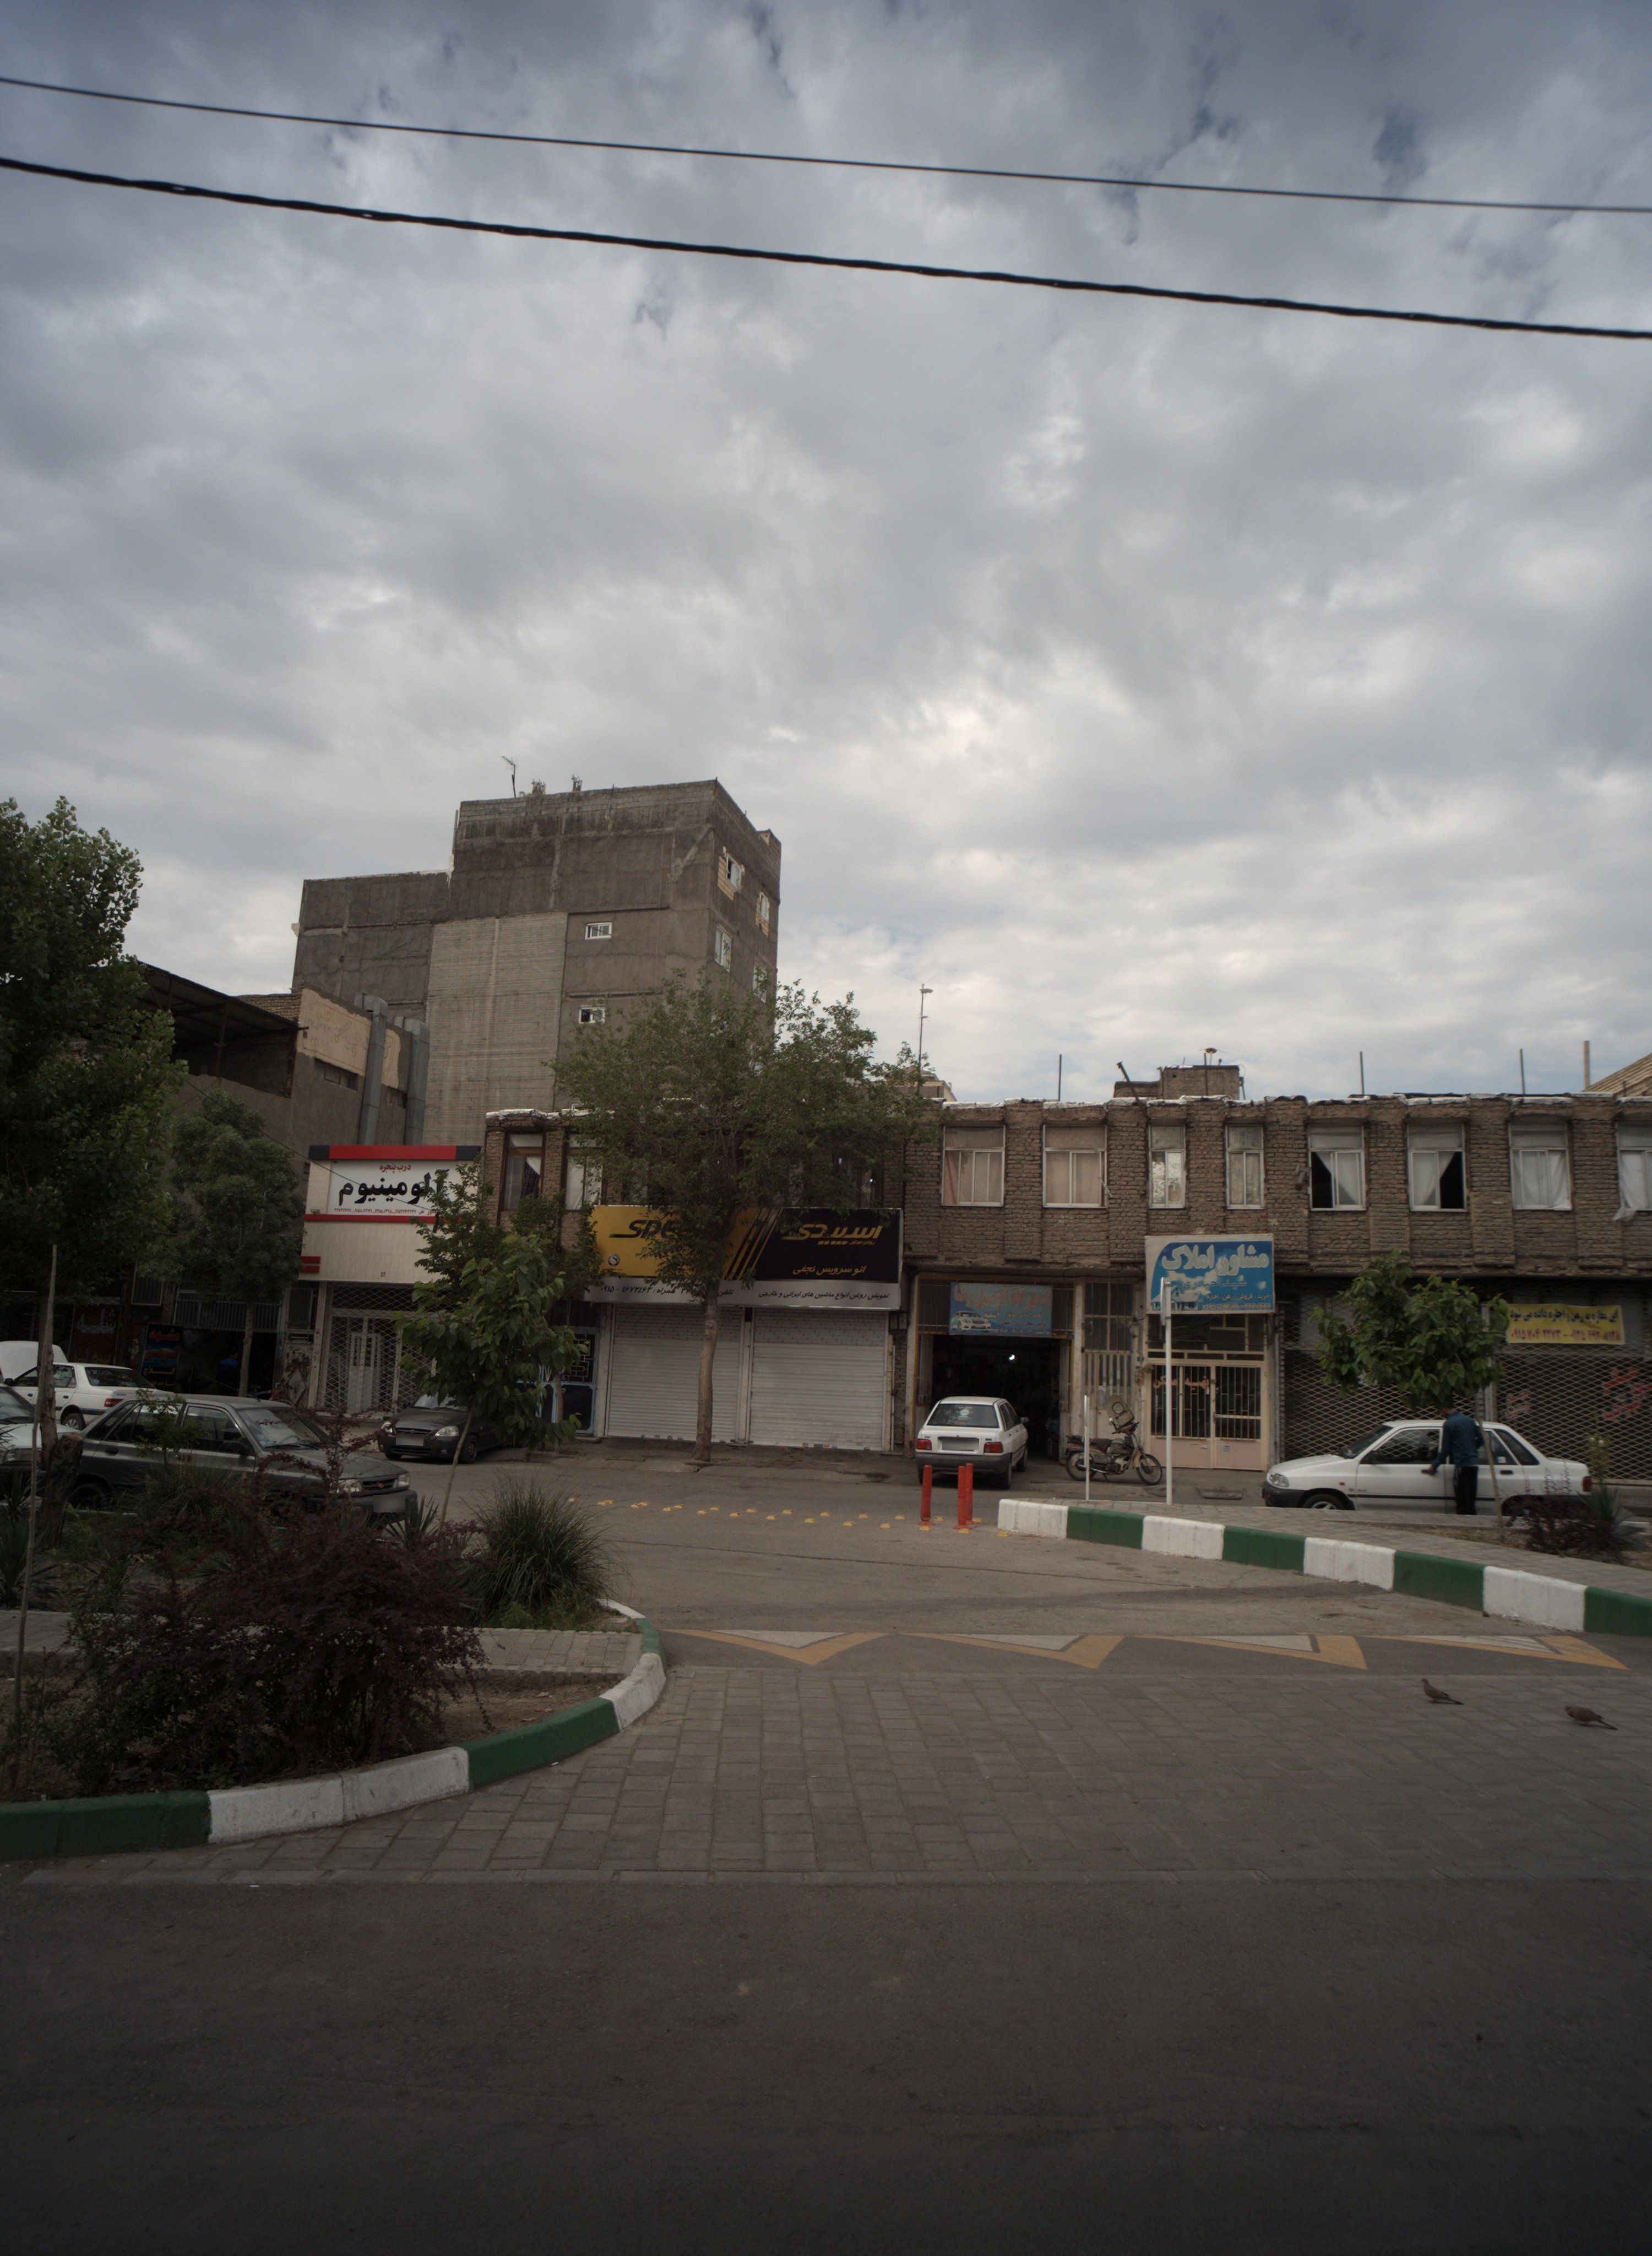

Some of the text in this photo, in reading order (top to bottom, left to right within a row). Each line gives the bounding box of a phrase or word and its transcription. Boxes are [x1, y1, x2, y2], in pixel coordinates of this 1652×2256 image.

[396, 1164, 411, 1173] درب
[1162, 1244, 1269, 1276] مشاور املاک
[793, 1265, 867, 1276] اتو سرویس نجفی
[835, 1292, 850, 1300] انواع
[868, 1292, 890, 1300] تعویض
